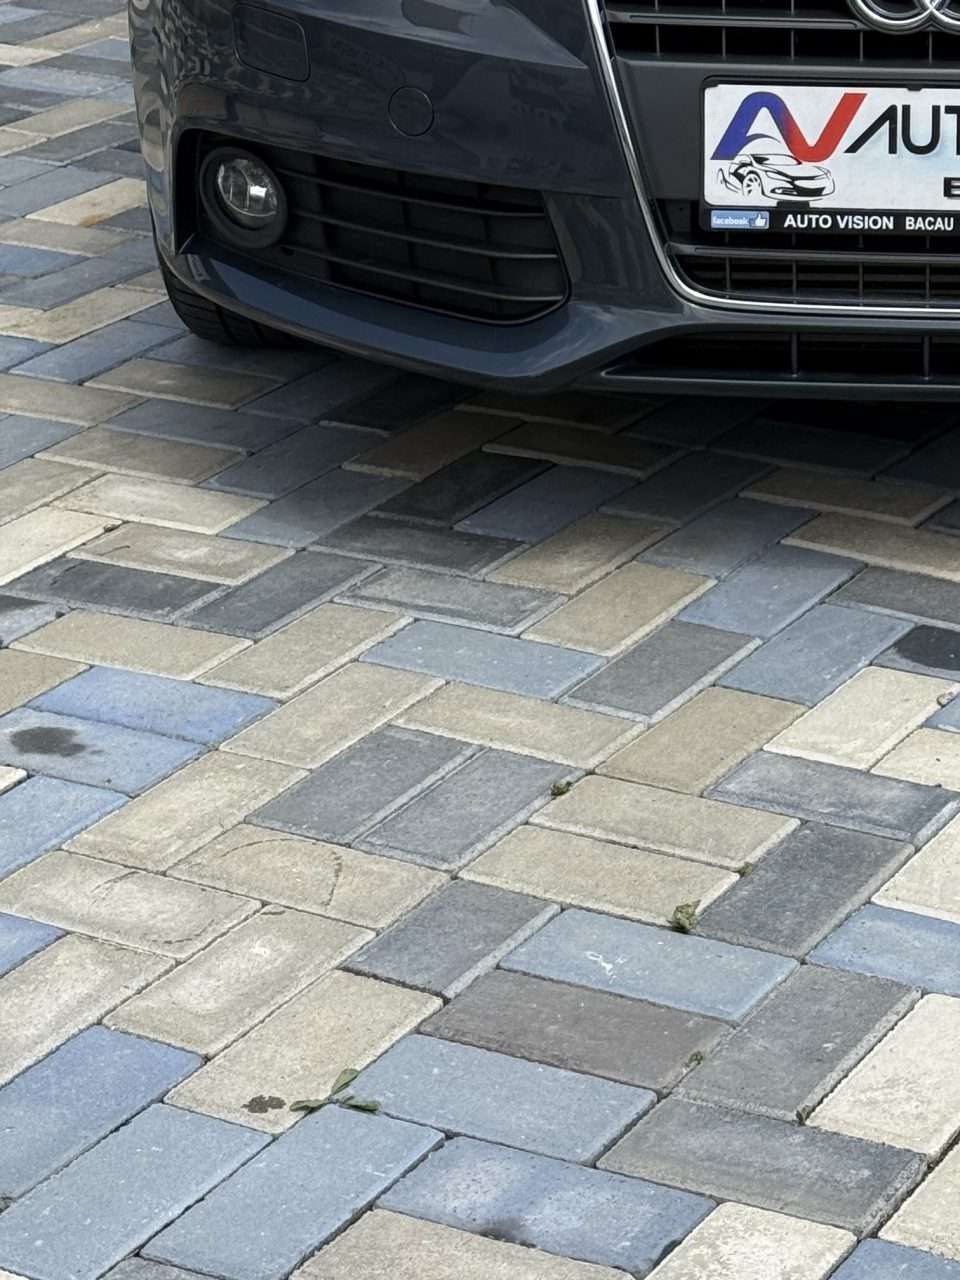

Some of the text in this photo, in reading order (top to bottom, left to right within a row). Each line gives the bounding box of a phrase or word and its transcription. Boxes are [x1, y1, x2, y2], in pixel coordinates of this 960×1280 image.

[784, 214, 832, 229] AUTO
[836, 215, 894, 230] VISION
[905, 217, 954, 231] BACAU
